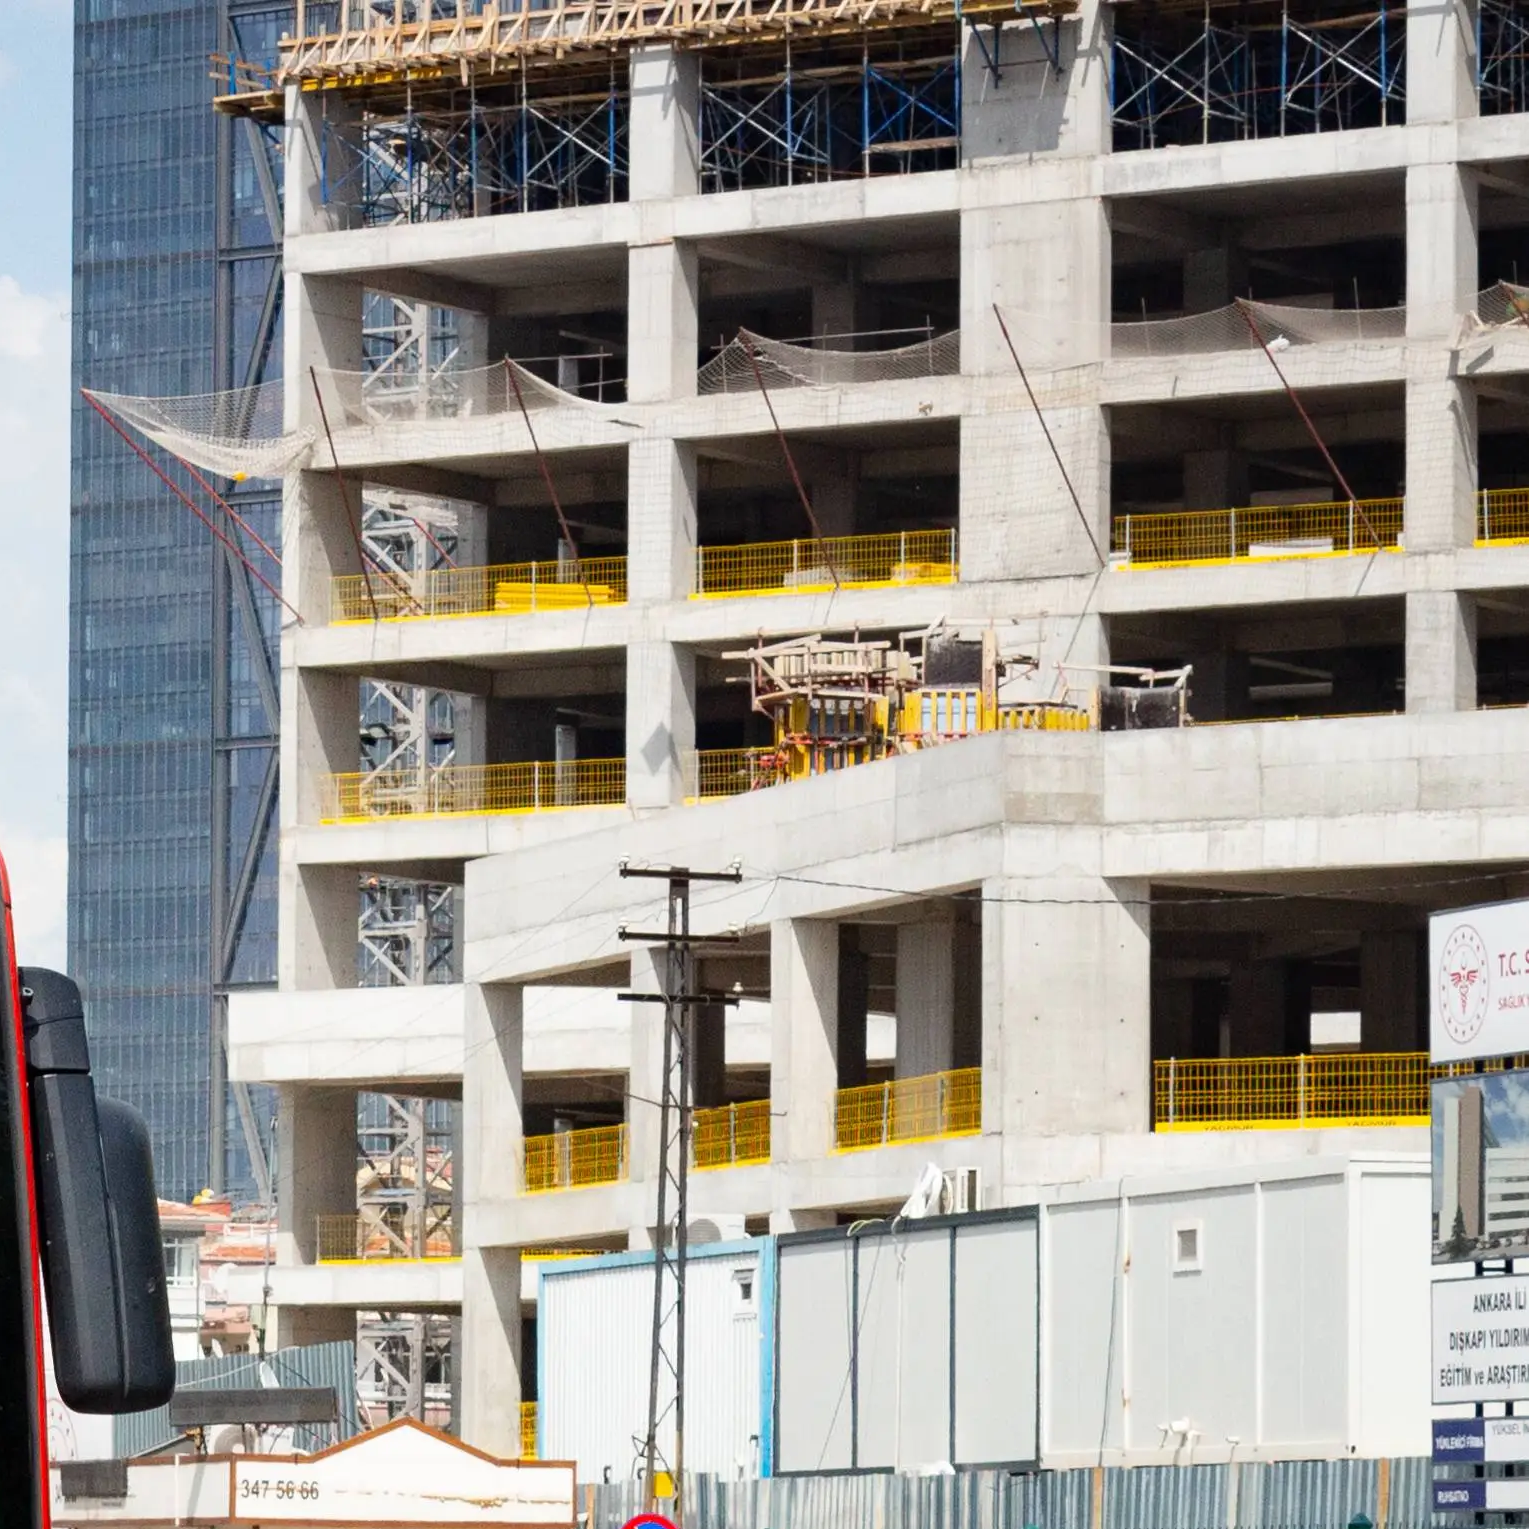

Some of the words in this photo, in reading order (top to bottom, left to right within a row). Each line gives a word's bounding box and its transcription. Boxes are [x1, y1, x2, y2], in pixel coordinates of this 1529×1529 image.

[1498, 952, 1521, 977] T.C.
[1473, 1291, 1512, 1313] ANKARA
[1515, 1286, 1527, 1310] İLİ
[1450, 1329, 1487, 1356] DIŞKAPI
[1440, 1362, 1472, 1387] EĞİTİM
[1474, 1370, 1485, 1385] ve
[241, 1479, 269, 1498] 347
[276, 1480, 295, 1500] 56
[300, 1480, 320, 1500] 66
